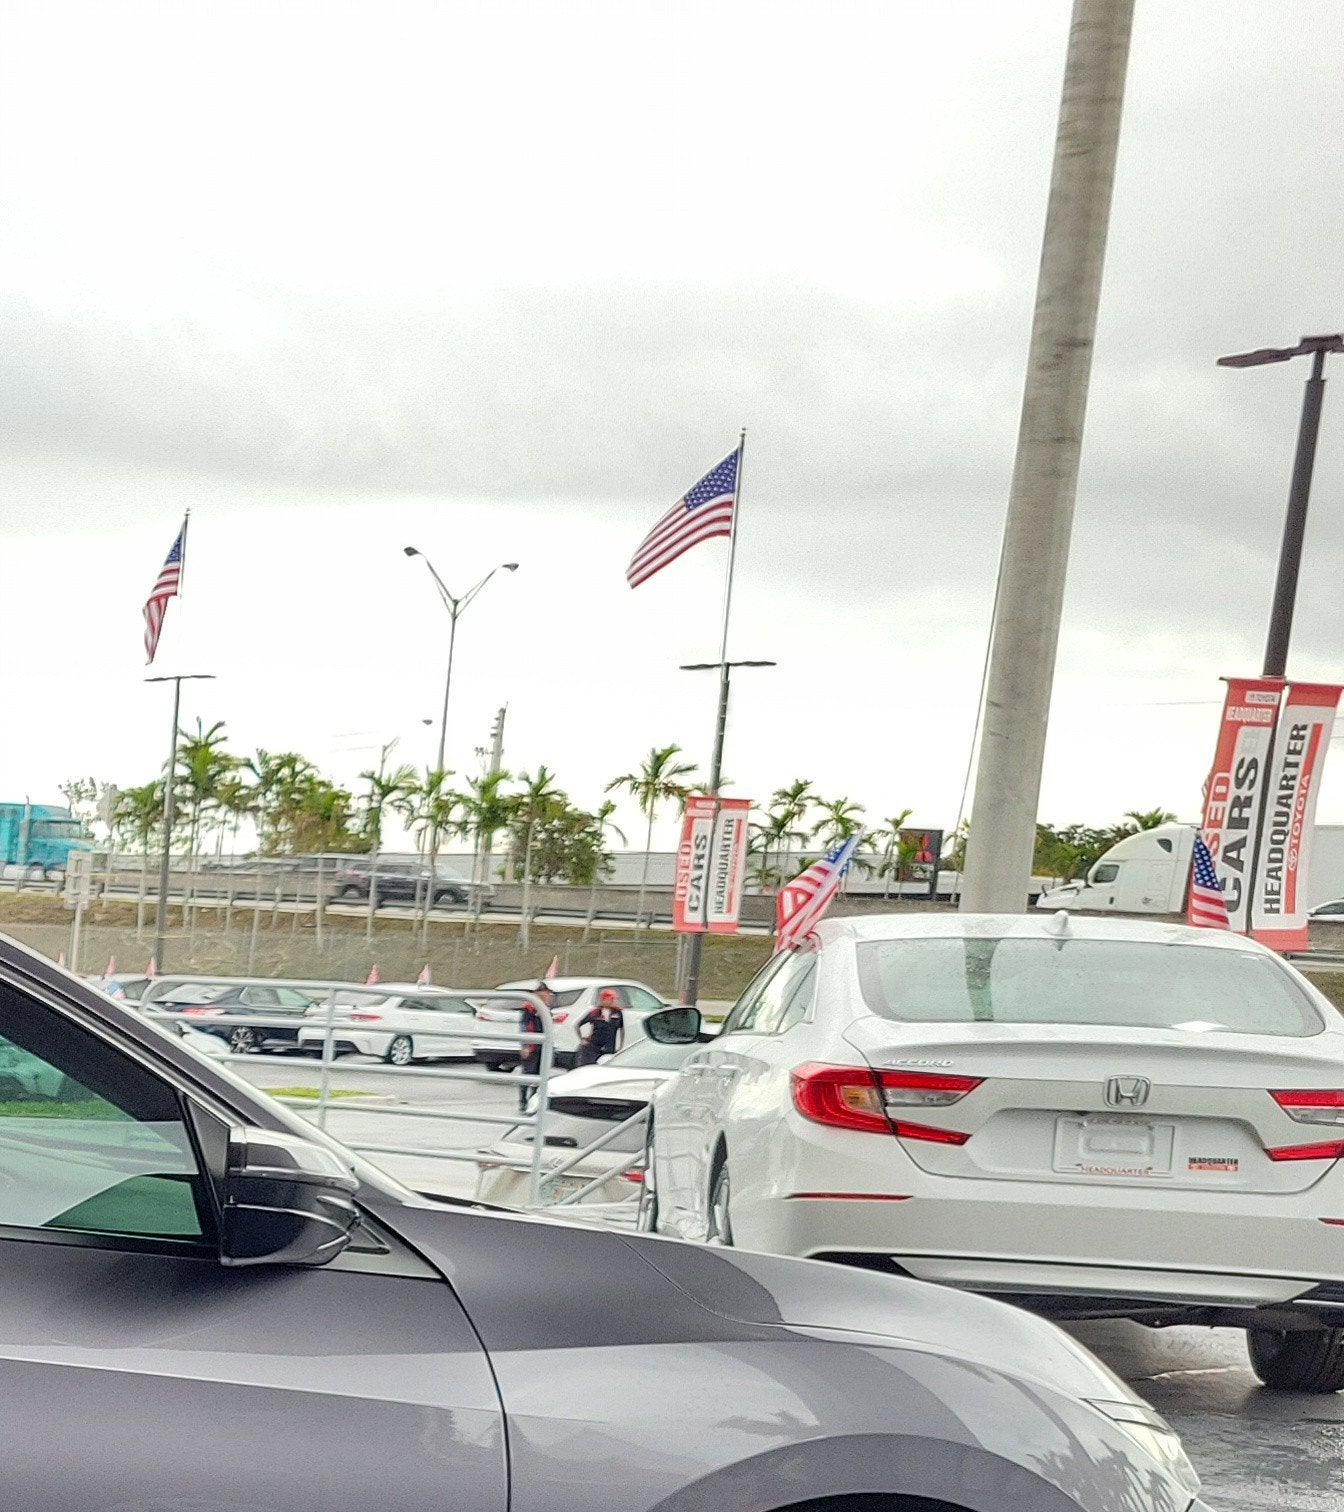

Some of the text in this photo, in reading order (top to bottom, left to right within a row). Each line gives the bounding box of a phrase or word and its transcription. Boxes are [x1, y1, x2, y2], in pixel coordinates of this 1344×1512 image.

[1203, 775, 1231, 870] SED
[1221, 756, 1259, 913] CARS
[1263, 723, 1309, 915] HEADQUARTER
[1290, 774, 1311, 850] TOYOTA
[675, 843, 691, 898] USED
[688, 833, 707, 912] CARS
[883, 1058, 955, 1068] ACCORD
